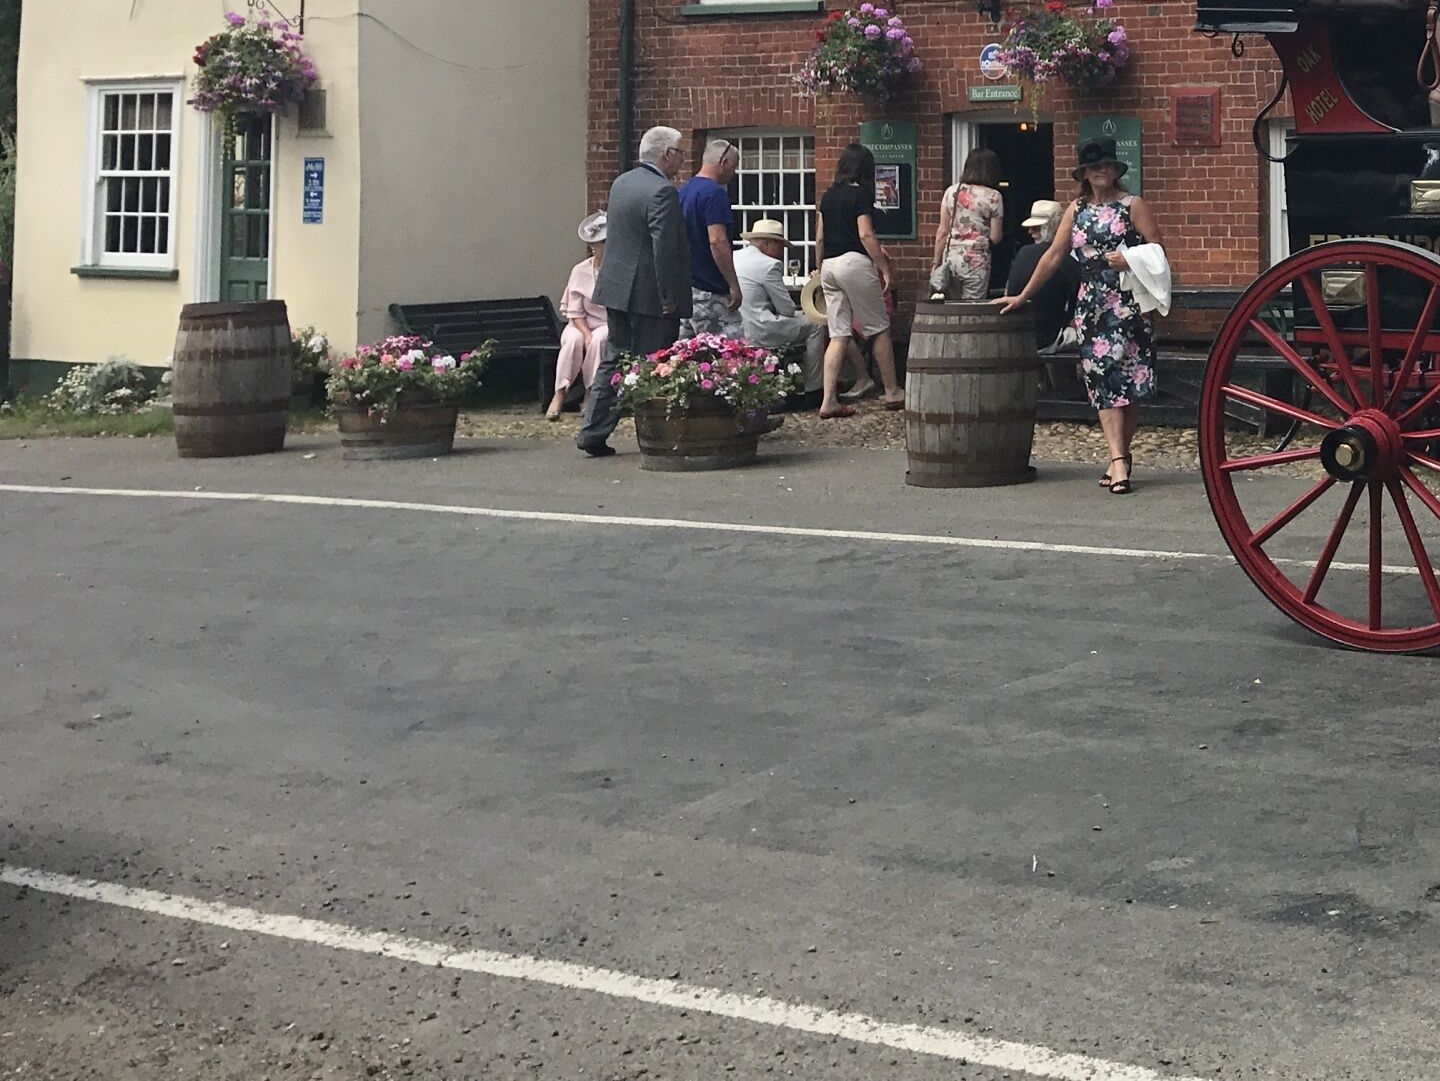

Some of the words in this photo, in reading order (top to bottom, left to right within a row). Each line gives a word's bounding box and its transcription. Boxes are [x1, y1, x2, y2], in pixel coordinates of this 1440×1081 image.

[1297, 43, 1323, 73] OAK
[971, 88, 985, 99] Bar
[985, 88, 1019, 99] Entrance
[1305, 88, 1340, 124] HOTEL
[875, 143, 913, 151] COMPASSES
